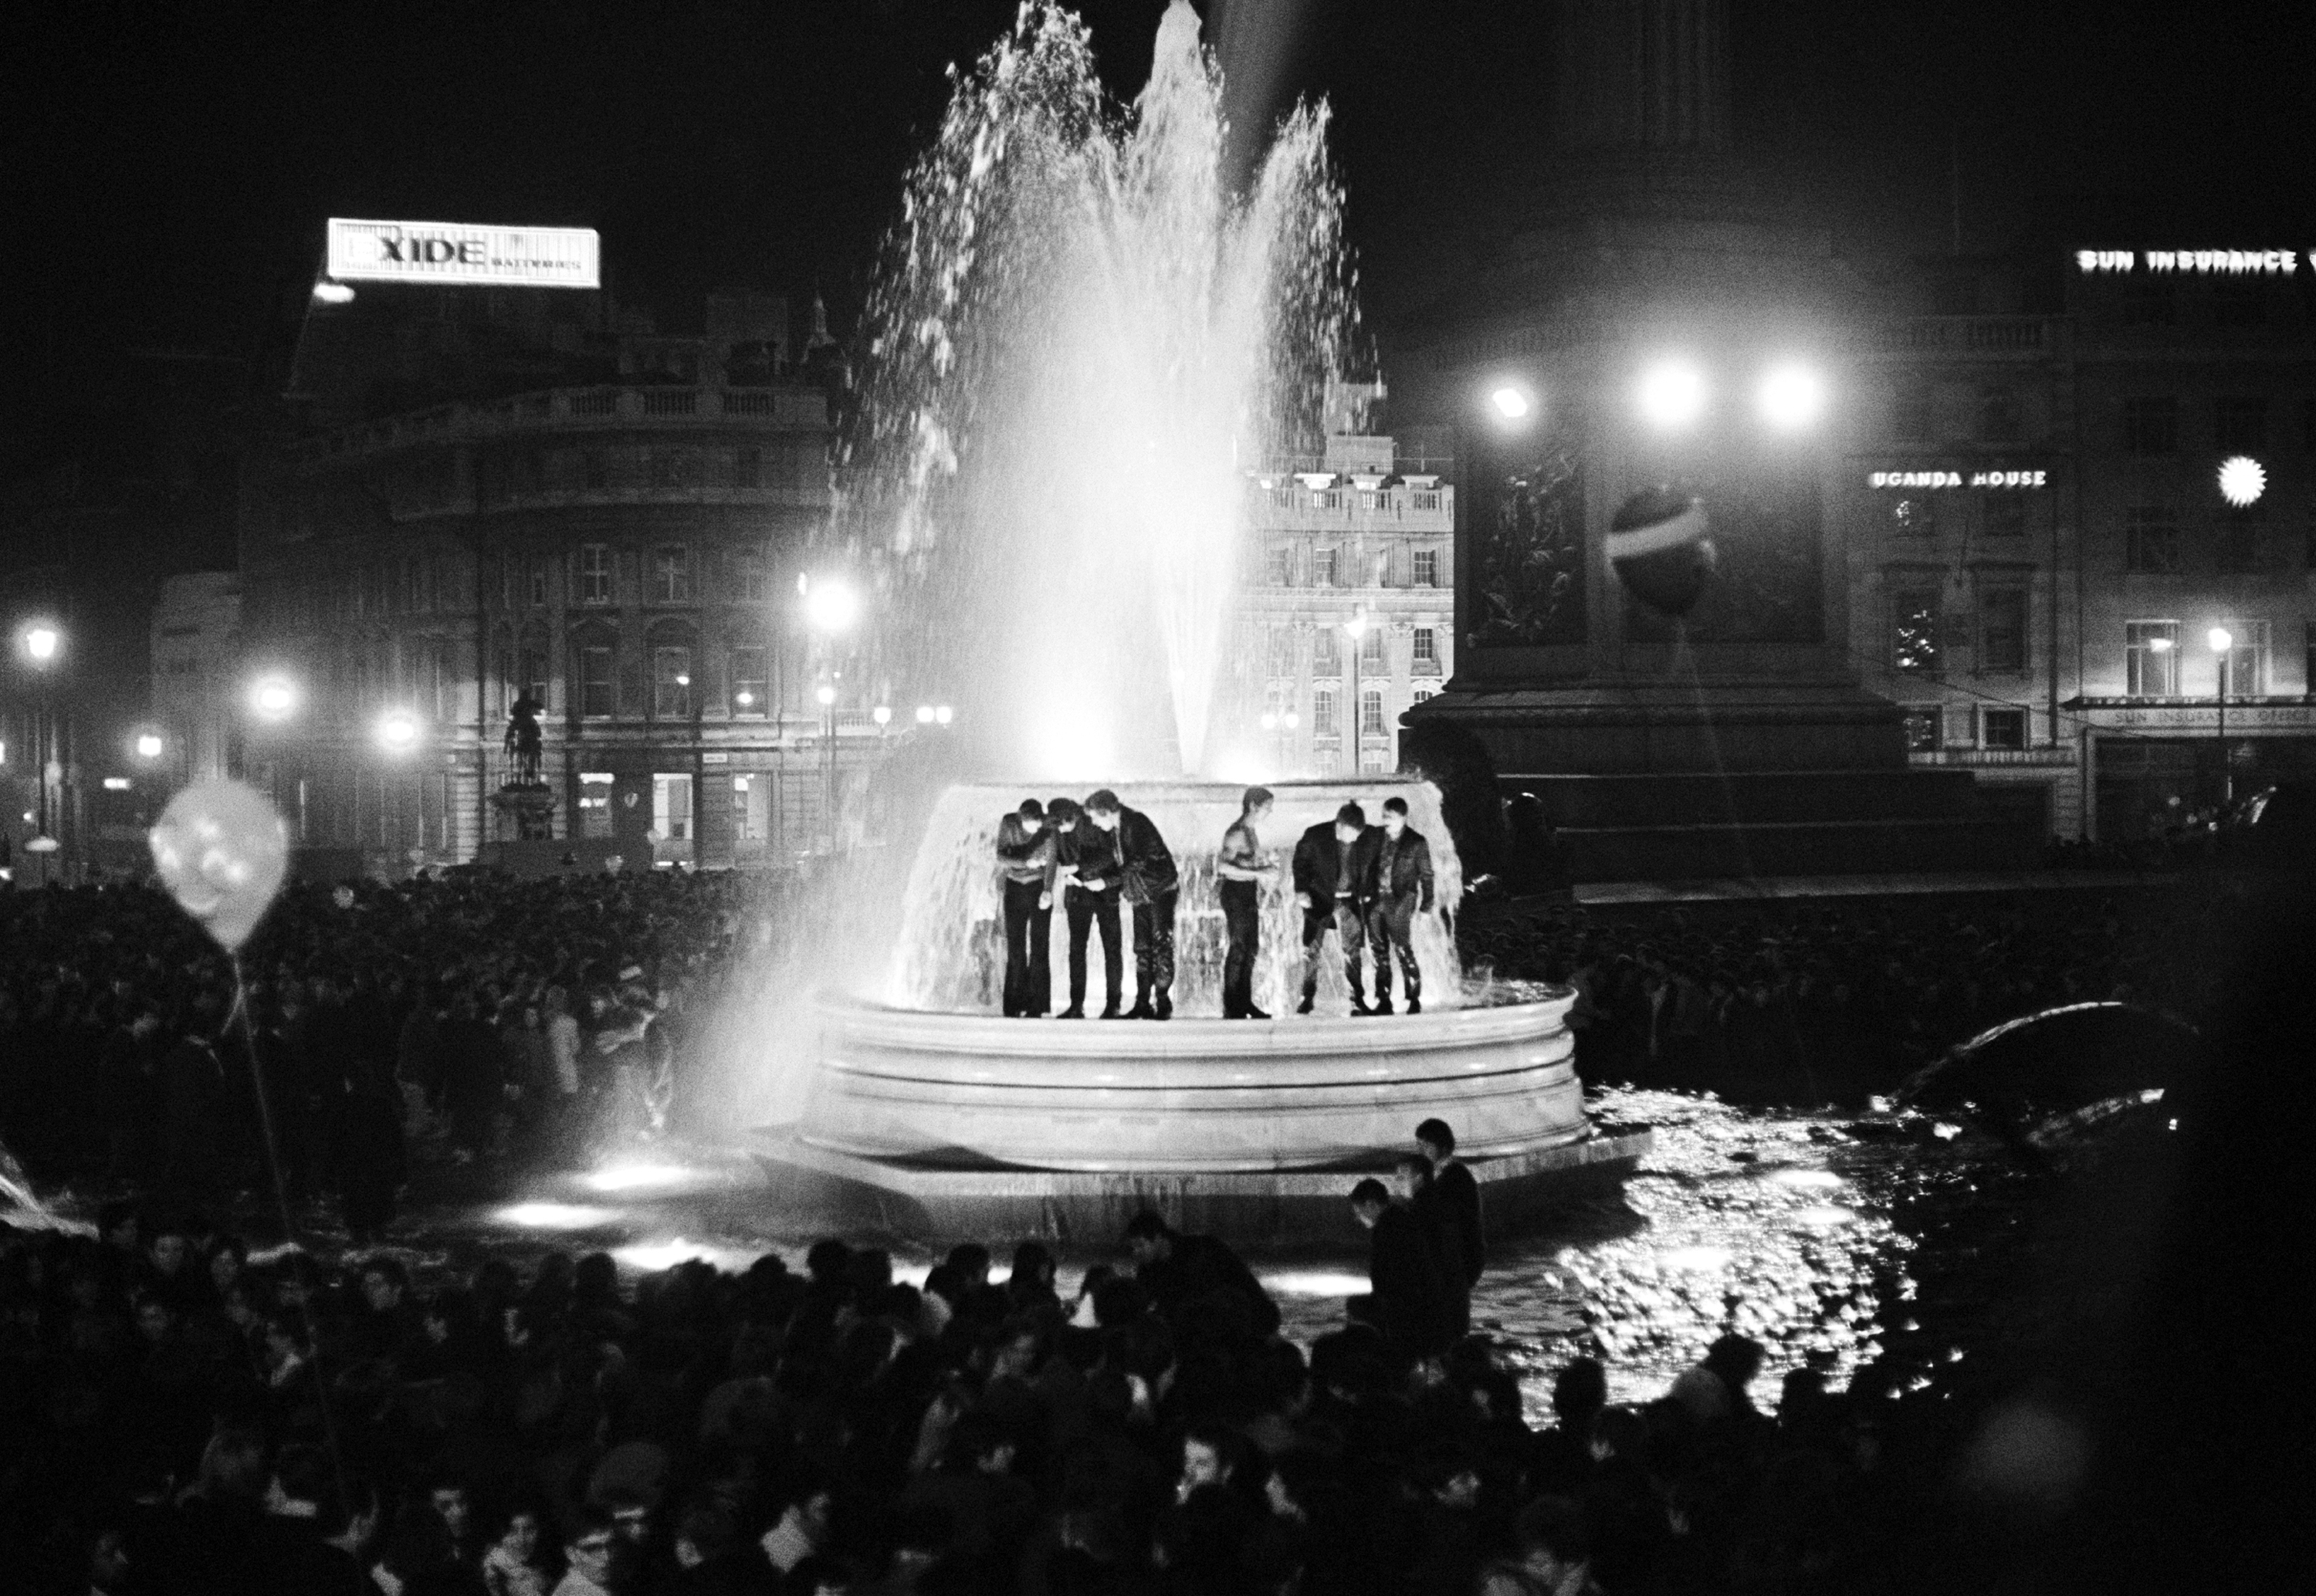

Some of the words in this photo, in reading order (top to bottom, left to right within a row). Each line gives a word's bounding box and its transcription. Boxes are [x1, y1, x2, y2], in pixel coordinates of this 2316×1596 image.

[2079, 250, 2134, 272] SUN
[2147, 250, 2297, 273] INSURANCE
[1871, 472, 1962, 488] UGANDA
[1972, 471, 2046, 486] HOUSE
[2159, 710, 2246, 723] INSURACE
